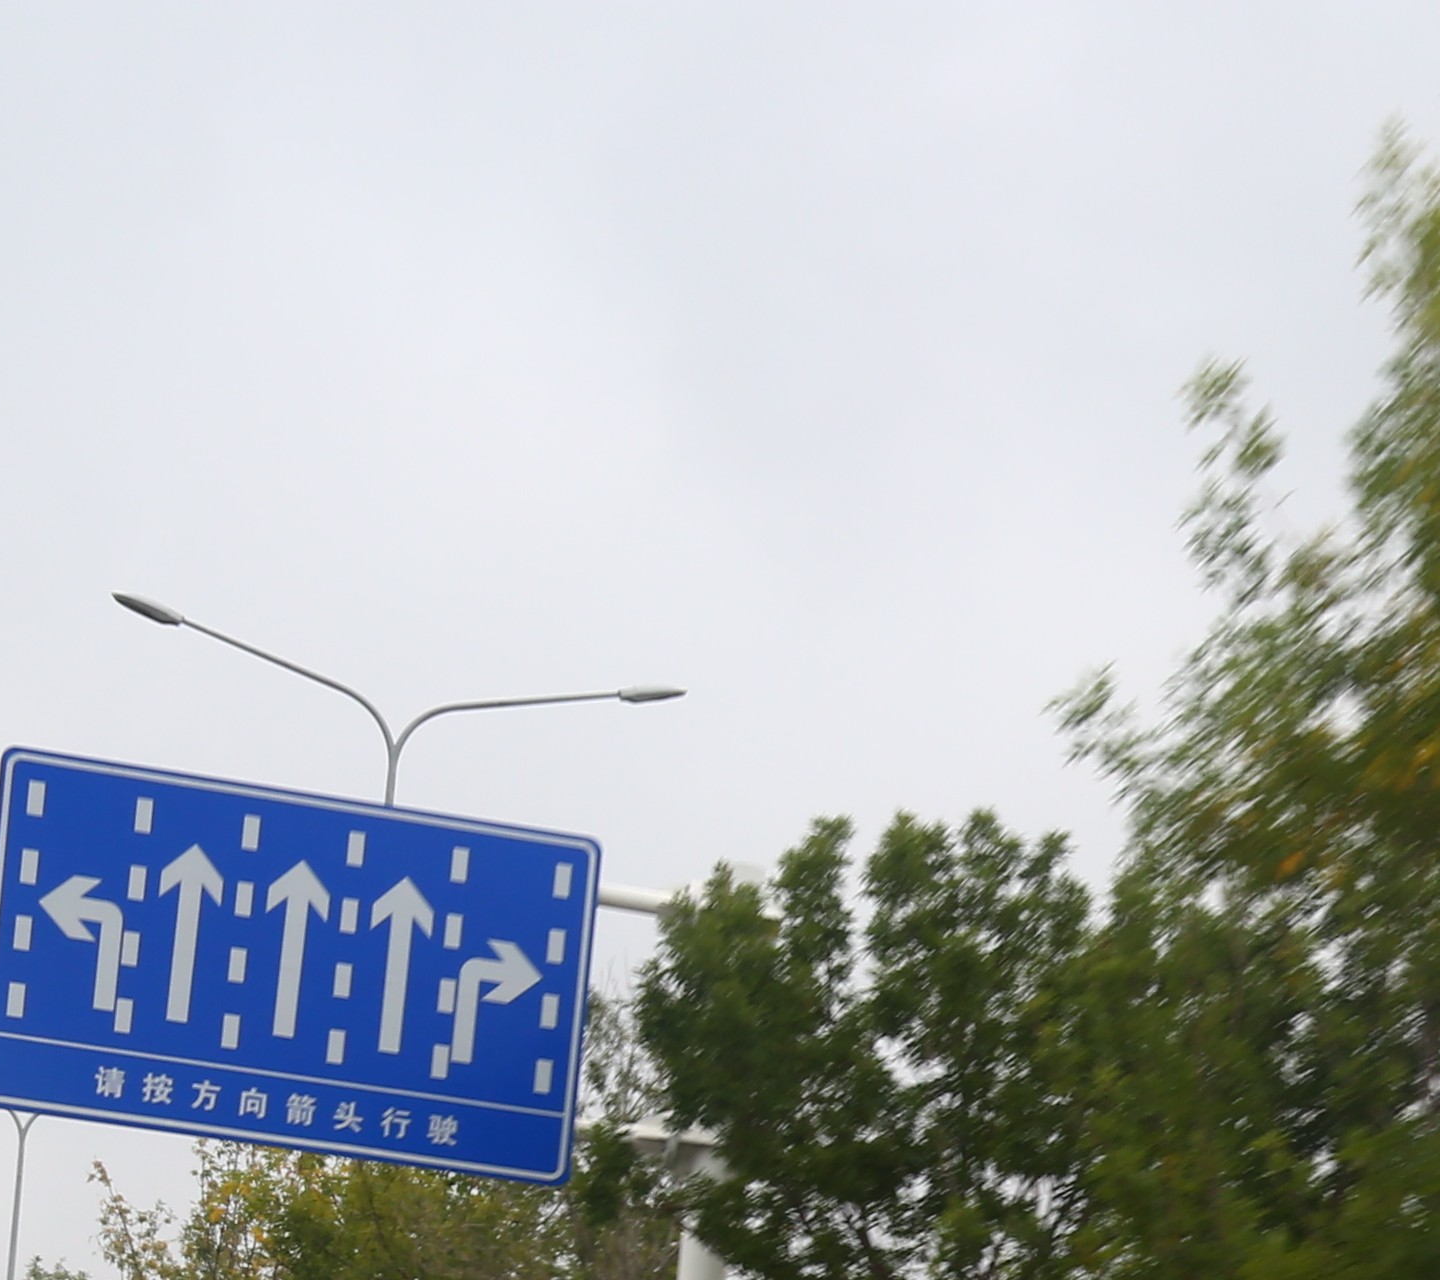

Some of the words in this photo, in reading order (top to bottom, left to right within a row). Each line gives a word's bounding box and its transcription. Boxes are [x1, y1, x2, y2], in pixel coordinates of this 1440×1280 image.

[94, 1065, 459, 1147] 请按方向箭头行驶
